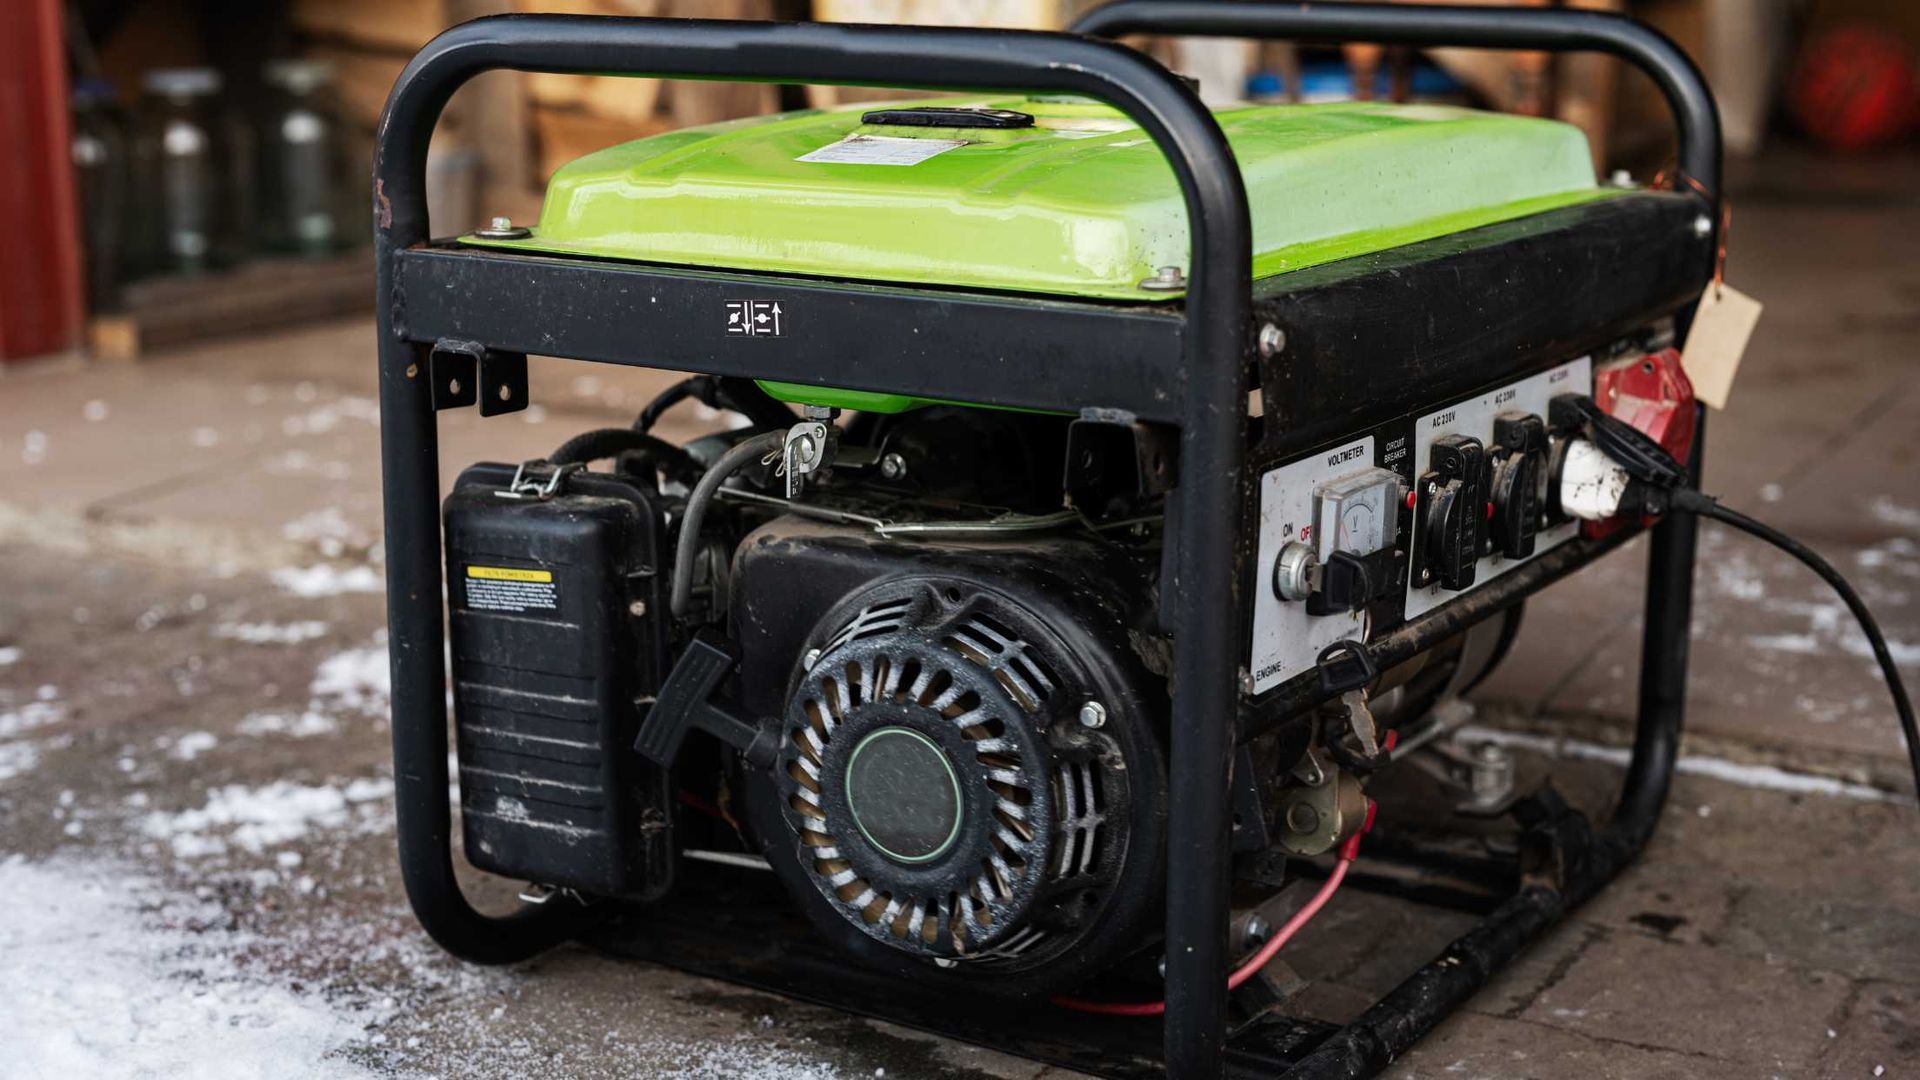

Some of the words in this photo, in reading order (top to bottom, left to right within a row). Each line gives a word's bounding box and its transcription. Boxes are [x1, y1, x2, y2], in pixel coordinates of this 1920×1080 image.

[1433, 417, 1441, 428] AC
[1442, 411, 1456, 425] 230V
[1386, 437, 1405, 451] CIRCUIT
[1328, 445, 1364, 467] VOLTMETER
[1384, 447, 1407, 463] BREAKER
[1283, 522, 1293, 538] ON
[1256, 661, 1281, 681] ENGINE
